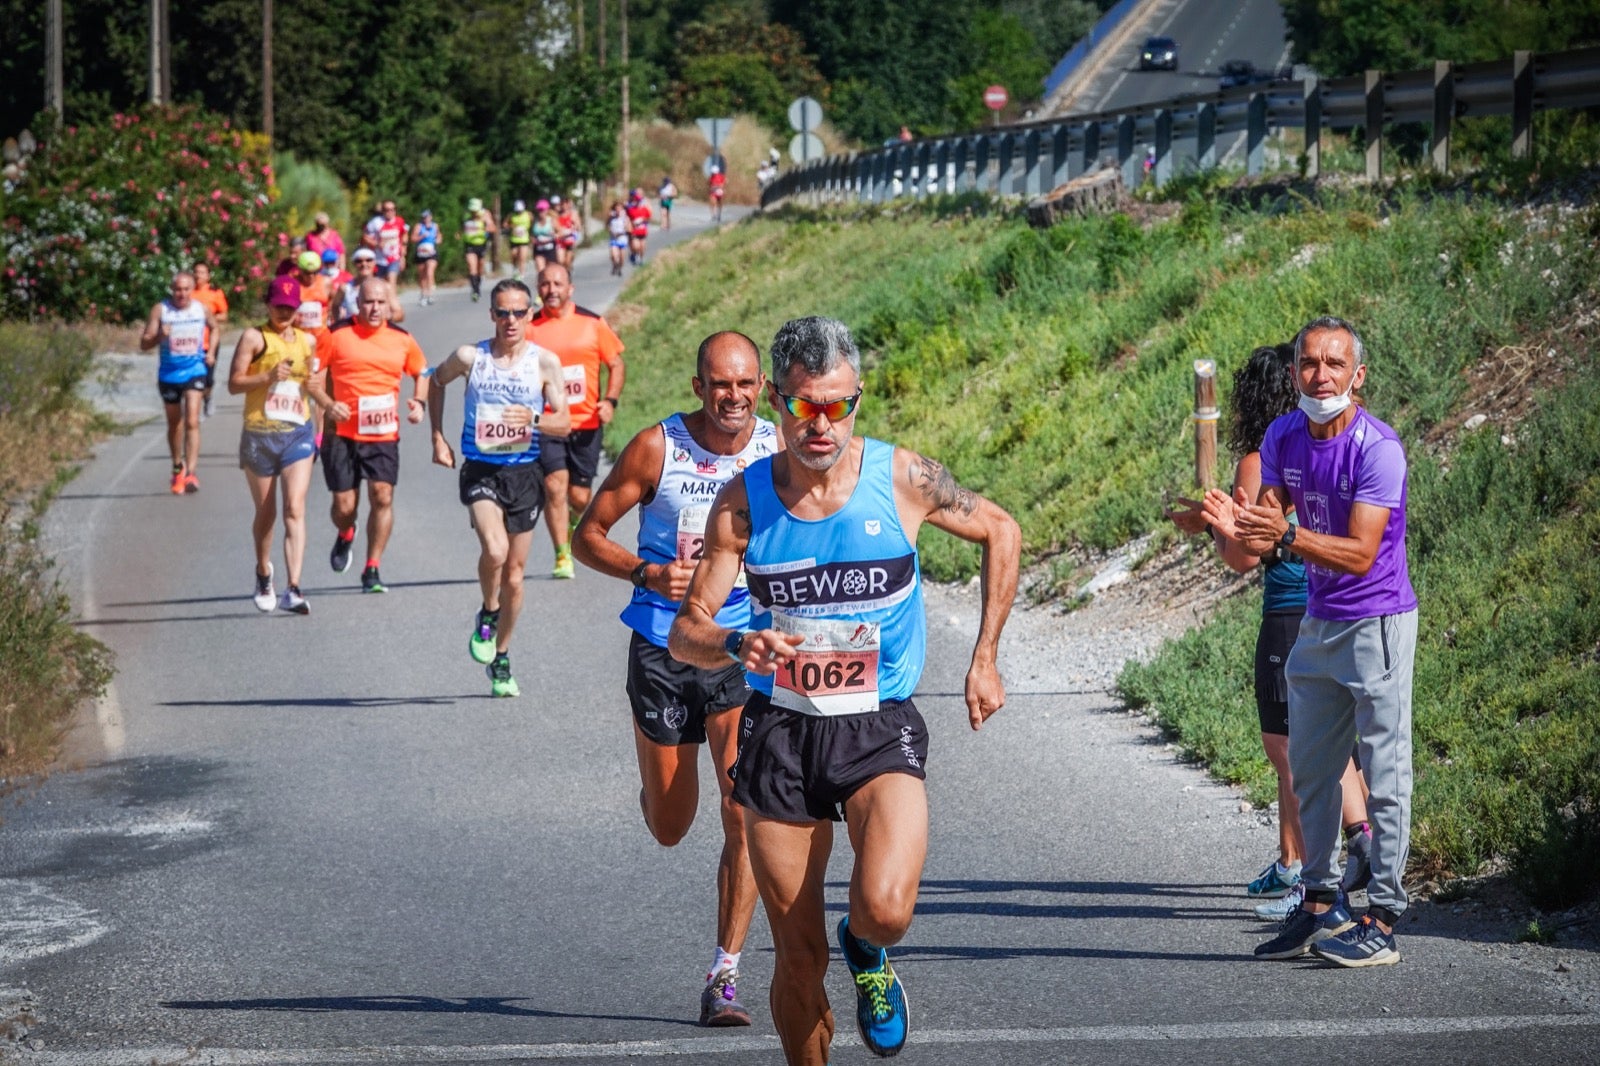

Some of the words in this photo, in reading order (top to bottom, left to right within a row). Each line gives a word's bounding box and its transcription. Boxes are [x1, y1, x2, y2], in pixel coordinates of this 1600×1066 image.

[366, 412, 393, 425] 1011
[485, 423, 527, 438] 2084
[784, 660, 866, 691] 1062
